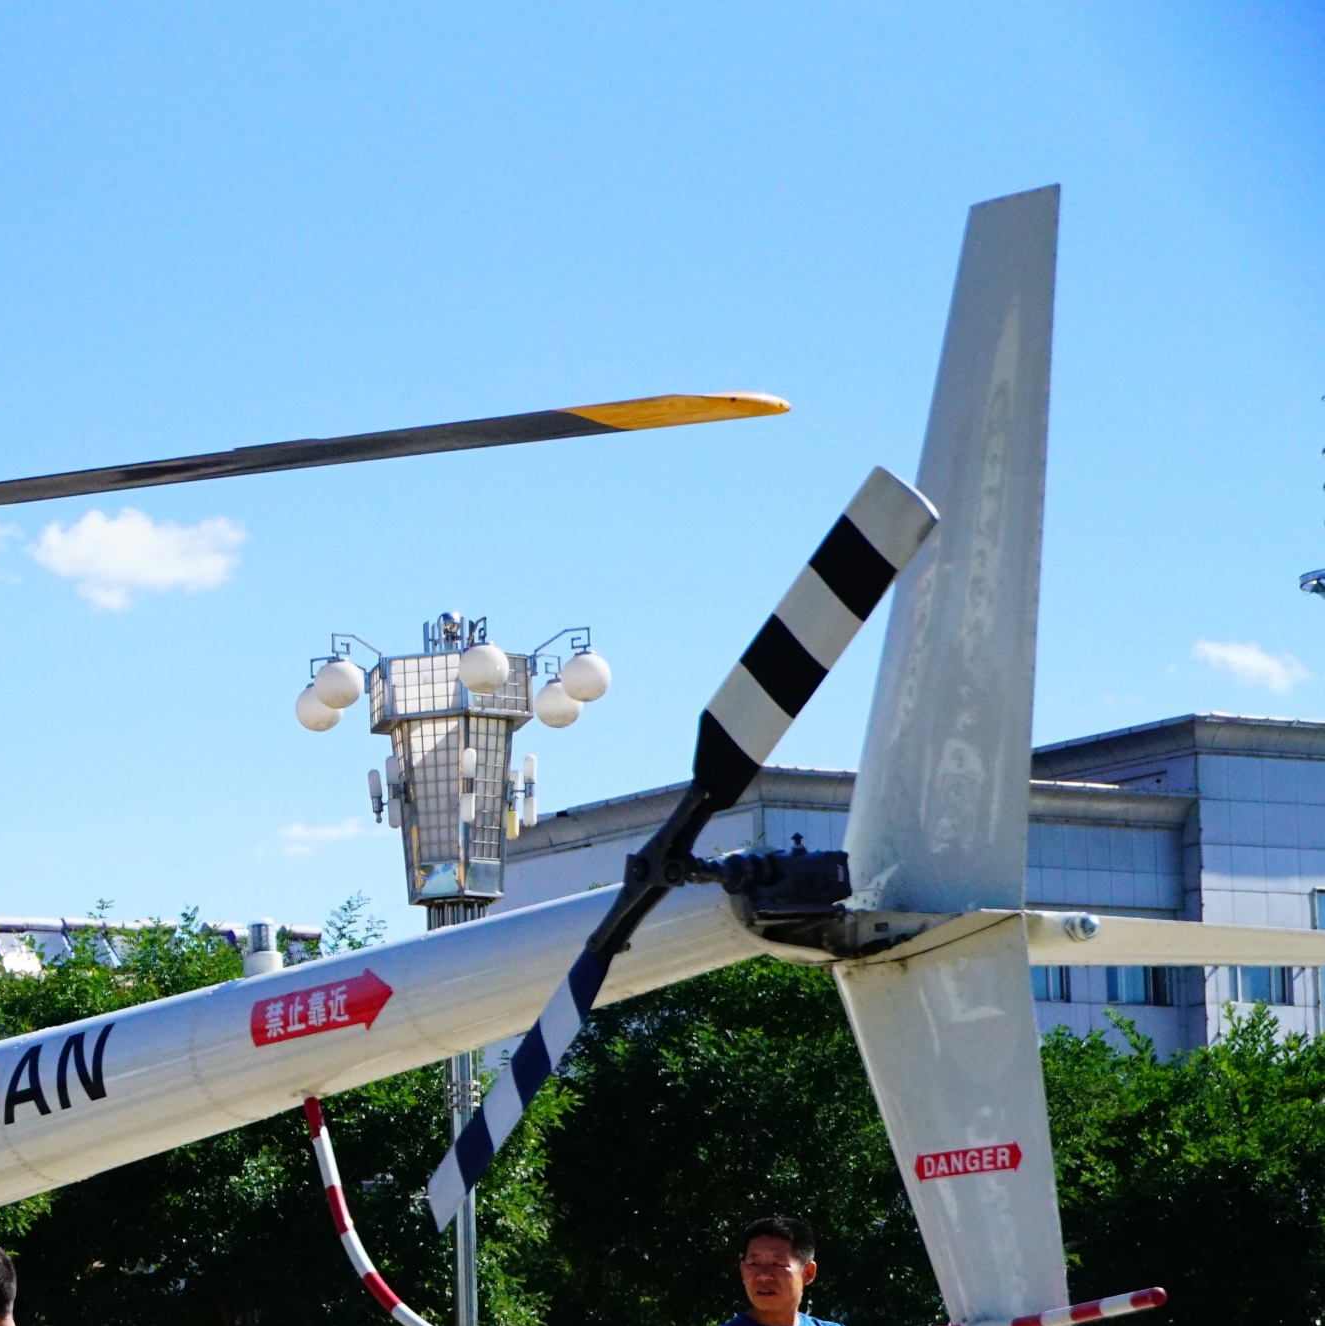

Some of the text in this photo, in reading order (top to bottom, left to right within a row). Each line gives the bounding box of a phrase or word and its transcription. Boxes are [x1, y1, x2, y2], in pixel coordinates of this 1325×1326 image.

[263, 994, 350, 1038] 禁止靠近
[923, 1147, 1011, 1177] DANGER
